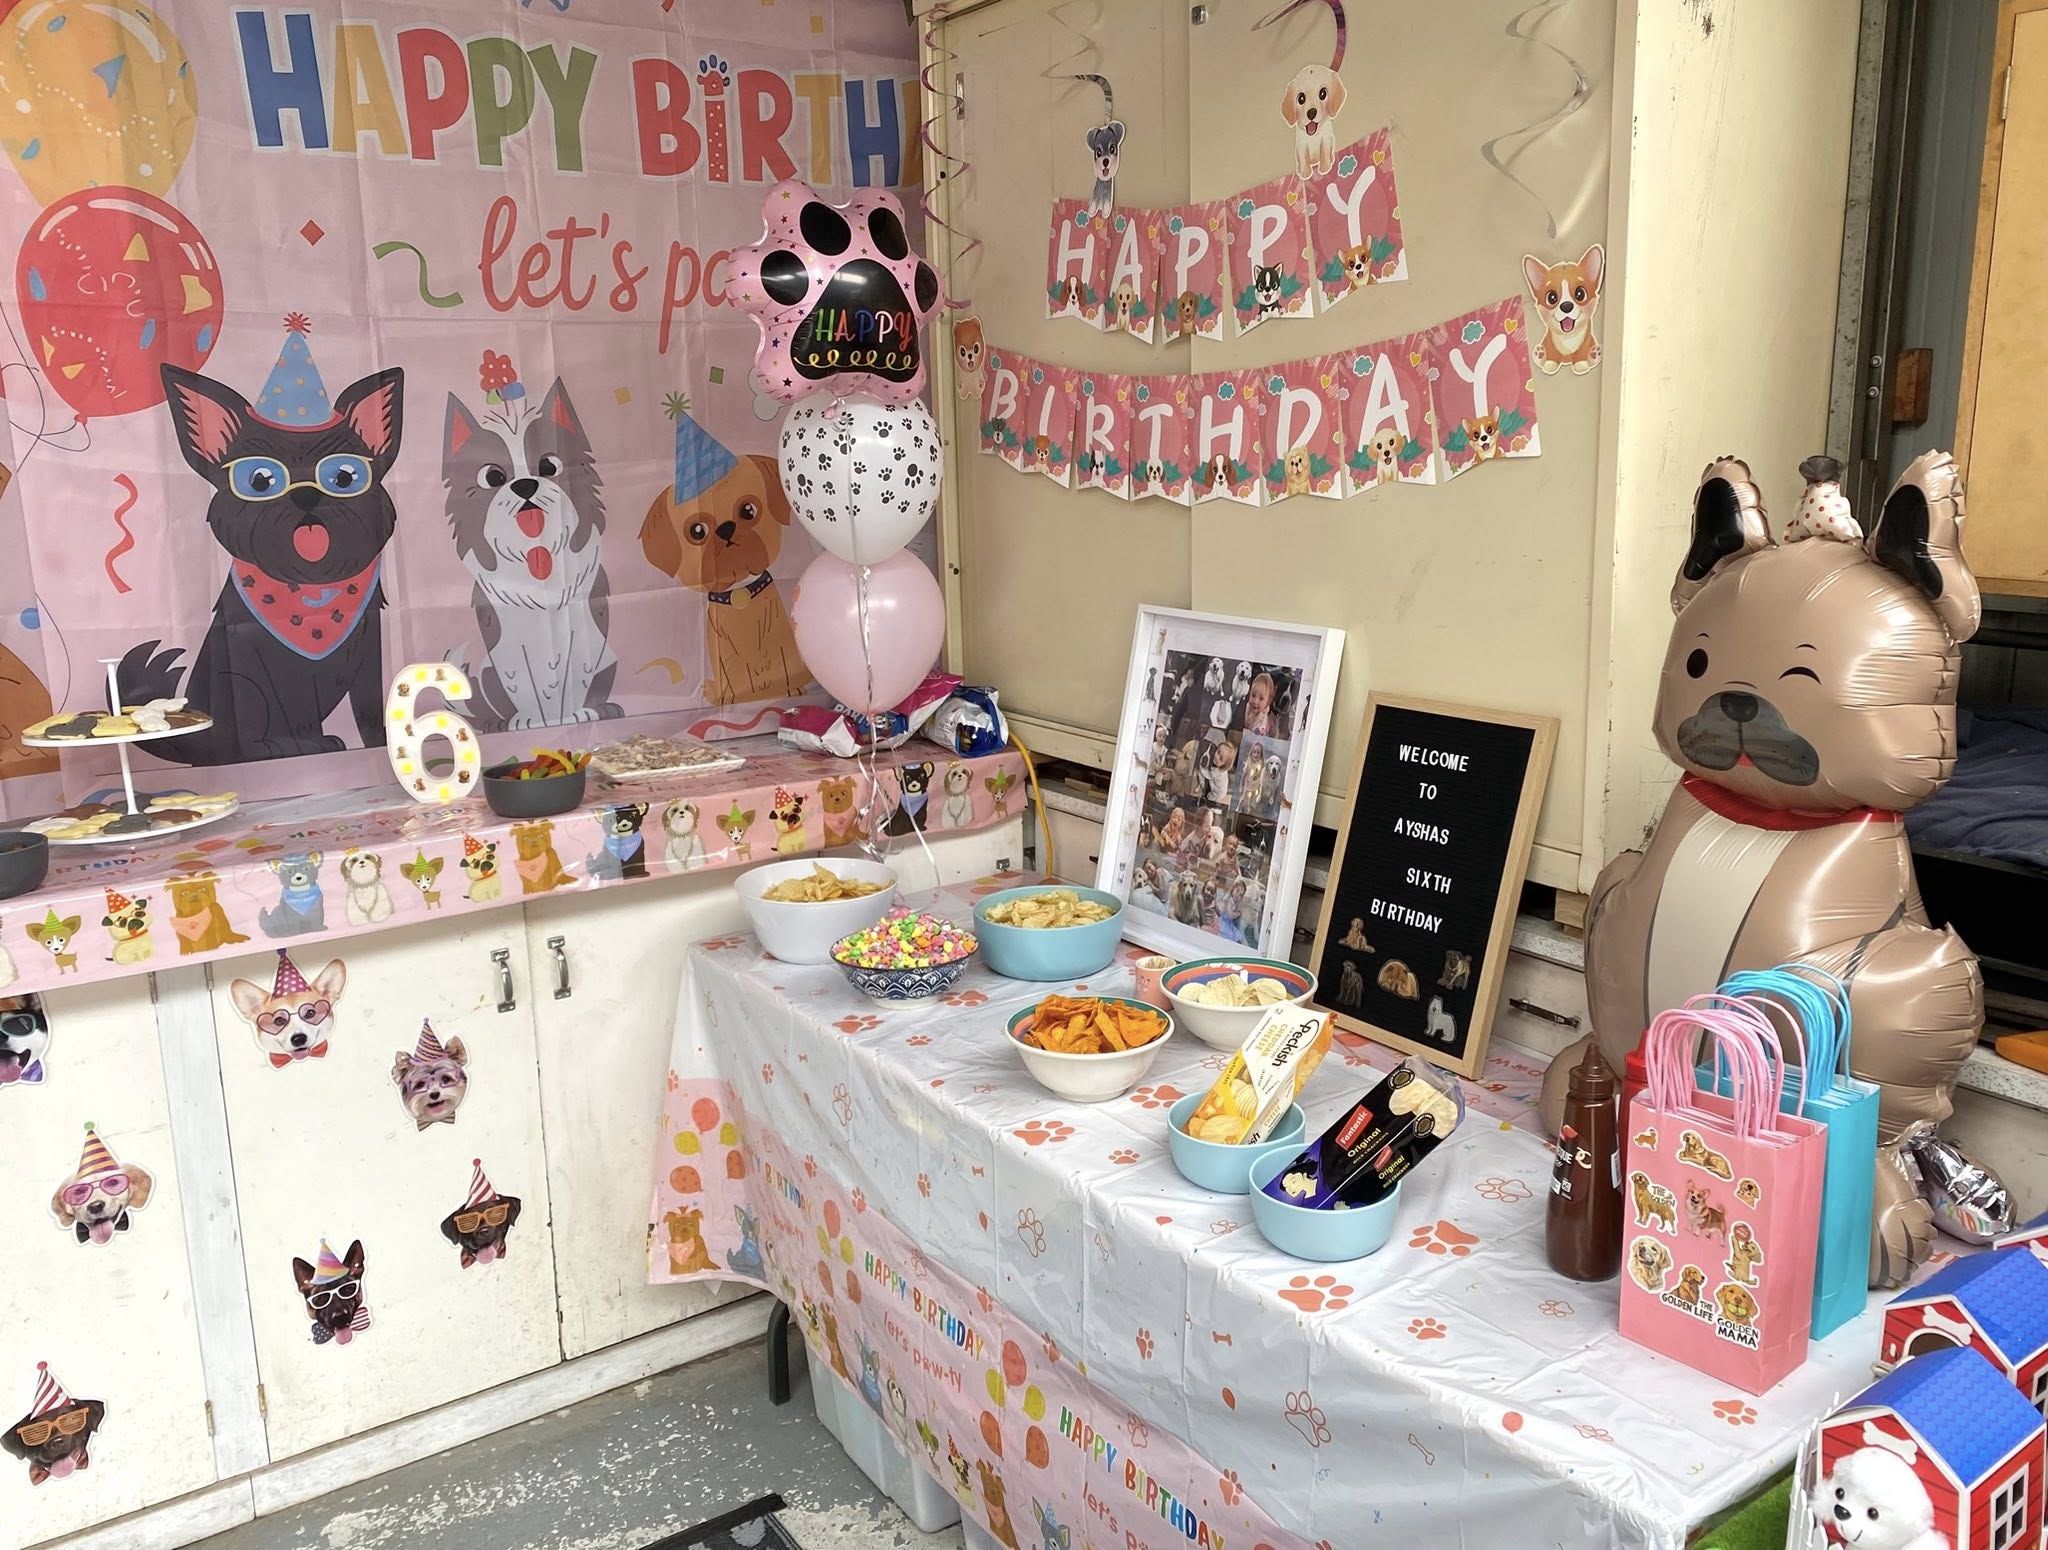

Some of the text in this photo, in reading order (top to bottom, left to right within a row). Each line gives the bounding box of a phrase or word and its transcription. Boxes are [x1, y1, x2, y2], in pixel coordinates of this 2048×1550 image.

[235, 10, 597, 173] HAPPY
[1058, 165, 1376, 302] HAPPY
[479, 195, 648, 312] let's
[816, 308, 913, 352] HAPPY
[987, 334, 1507, 461] BIRTHDAY
[386, 663, 482, 803] 6
[1399, 744, 1470, 773] WELCOME
[1419, 782, 1438, 800] TO
[1394, 817, 1450, 846] AYSHAS
[1406, 867, 1452, 895] SIXTH
[1370, 898, 1443, 934] BIRTHDAY
[1272, 1019, 1319, 1068] Peckish
[1340, 1110, 1369, 1145] Fantastic
[1347, 1127, 1381, 1158] Original
[1378, 1154, 1405, 1180] Original
[1651, 1185, 1666, 1197] THE
[865, 1250, 985, 1362] HAPPY BIRTHDAY
[1661, 1293, 1713, 1322] GOLDEN LIFE
[1700, 1300, 1713, 1312] THE
[884, 1311, 909, 1352] let's
[1717, 1317, 1759, 1339] GOLDEN
[1718, 1326, 1757, 1348] MAMA
[1059, 1405, 1225, 1550] HAPPY BIRTHDAY
[1083, 1481, 1118, 1534] let's
